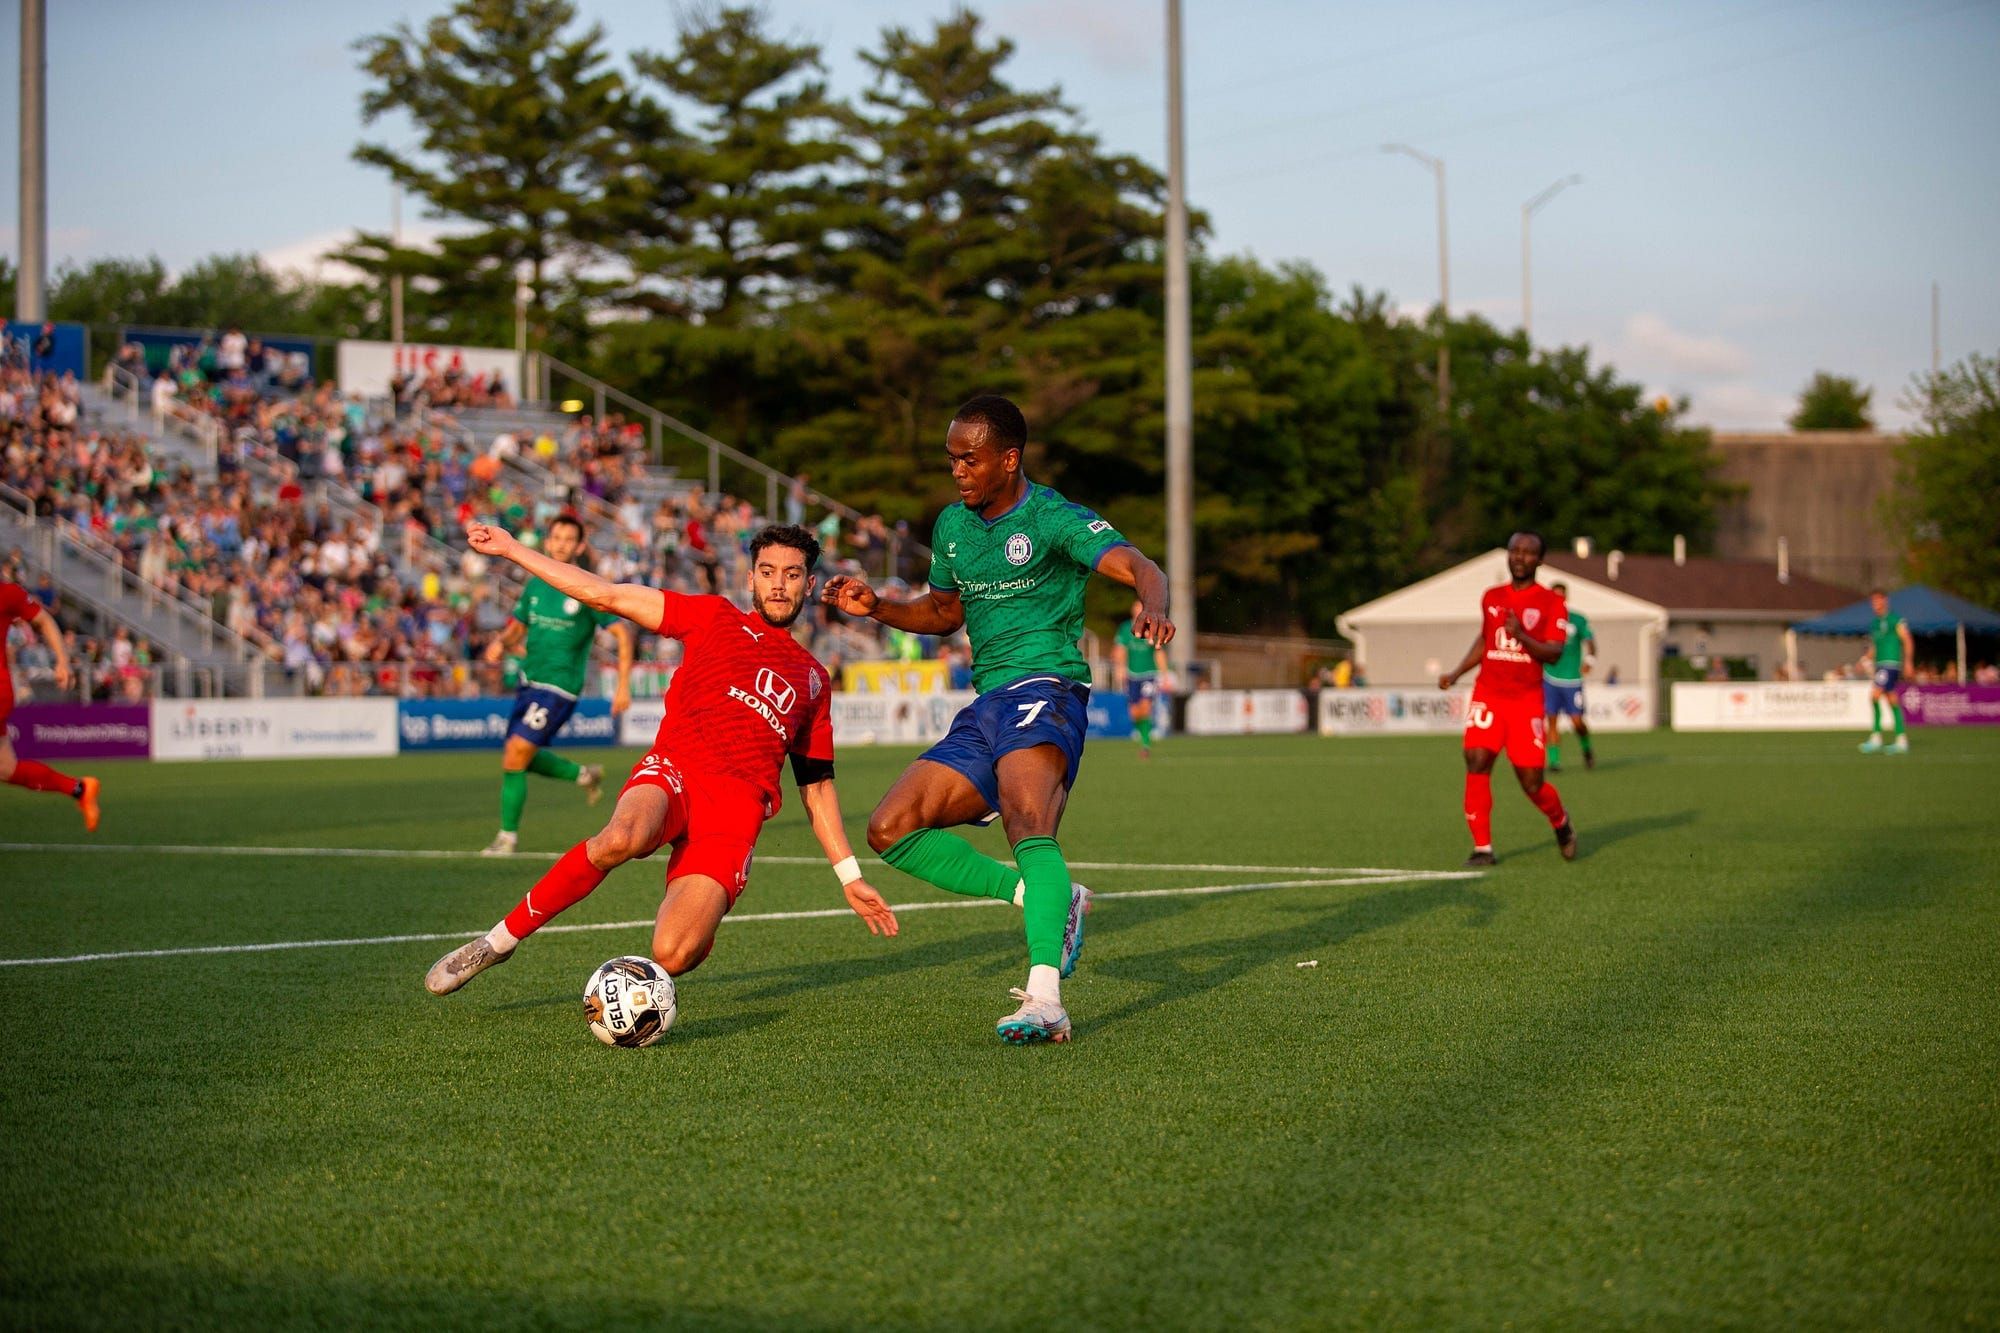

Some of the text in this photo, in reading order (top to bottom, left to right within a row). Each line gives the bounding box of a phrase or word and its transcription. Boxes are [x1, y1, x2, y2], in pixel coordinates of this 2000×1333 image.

[522, 701, 549, 731] 16
[1016, 700, 1049, 727] 7
[605, 978, 627, 1030] SELECT
